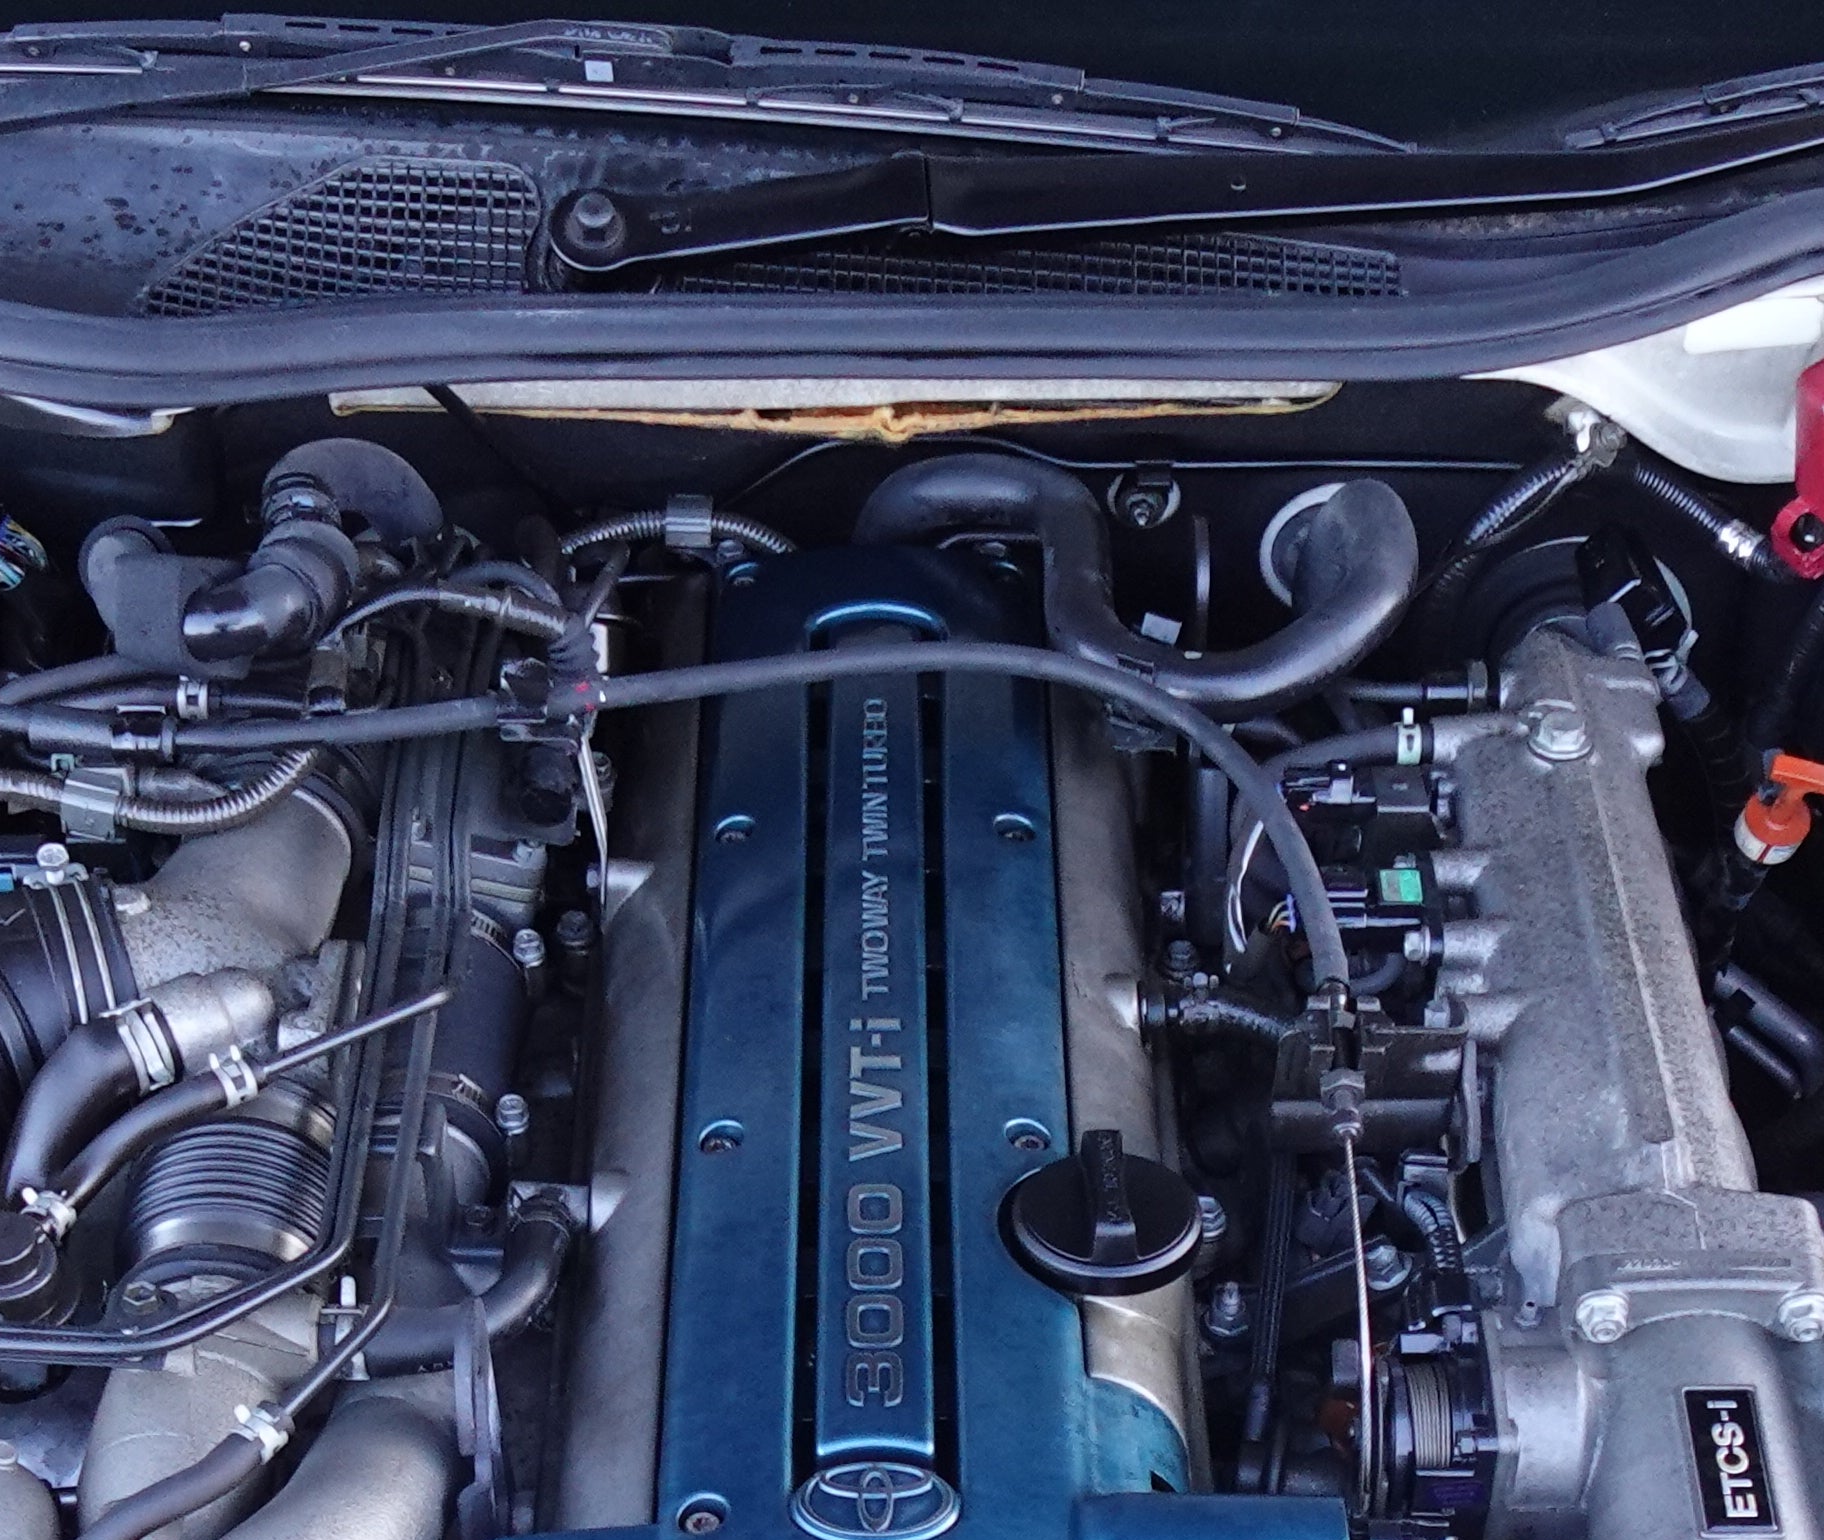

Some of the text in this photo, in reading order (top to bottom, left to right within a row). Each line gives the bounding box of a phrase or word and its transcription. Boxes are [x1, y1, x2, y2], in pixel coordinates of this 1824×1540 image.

[848, 1017, 904, 1162] VVT-i
[847, 1183, 904, 1409] 3000
[1706, 1400, 1759, 1519] ETCS-i
